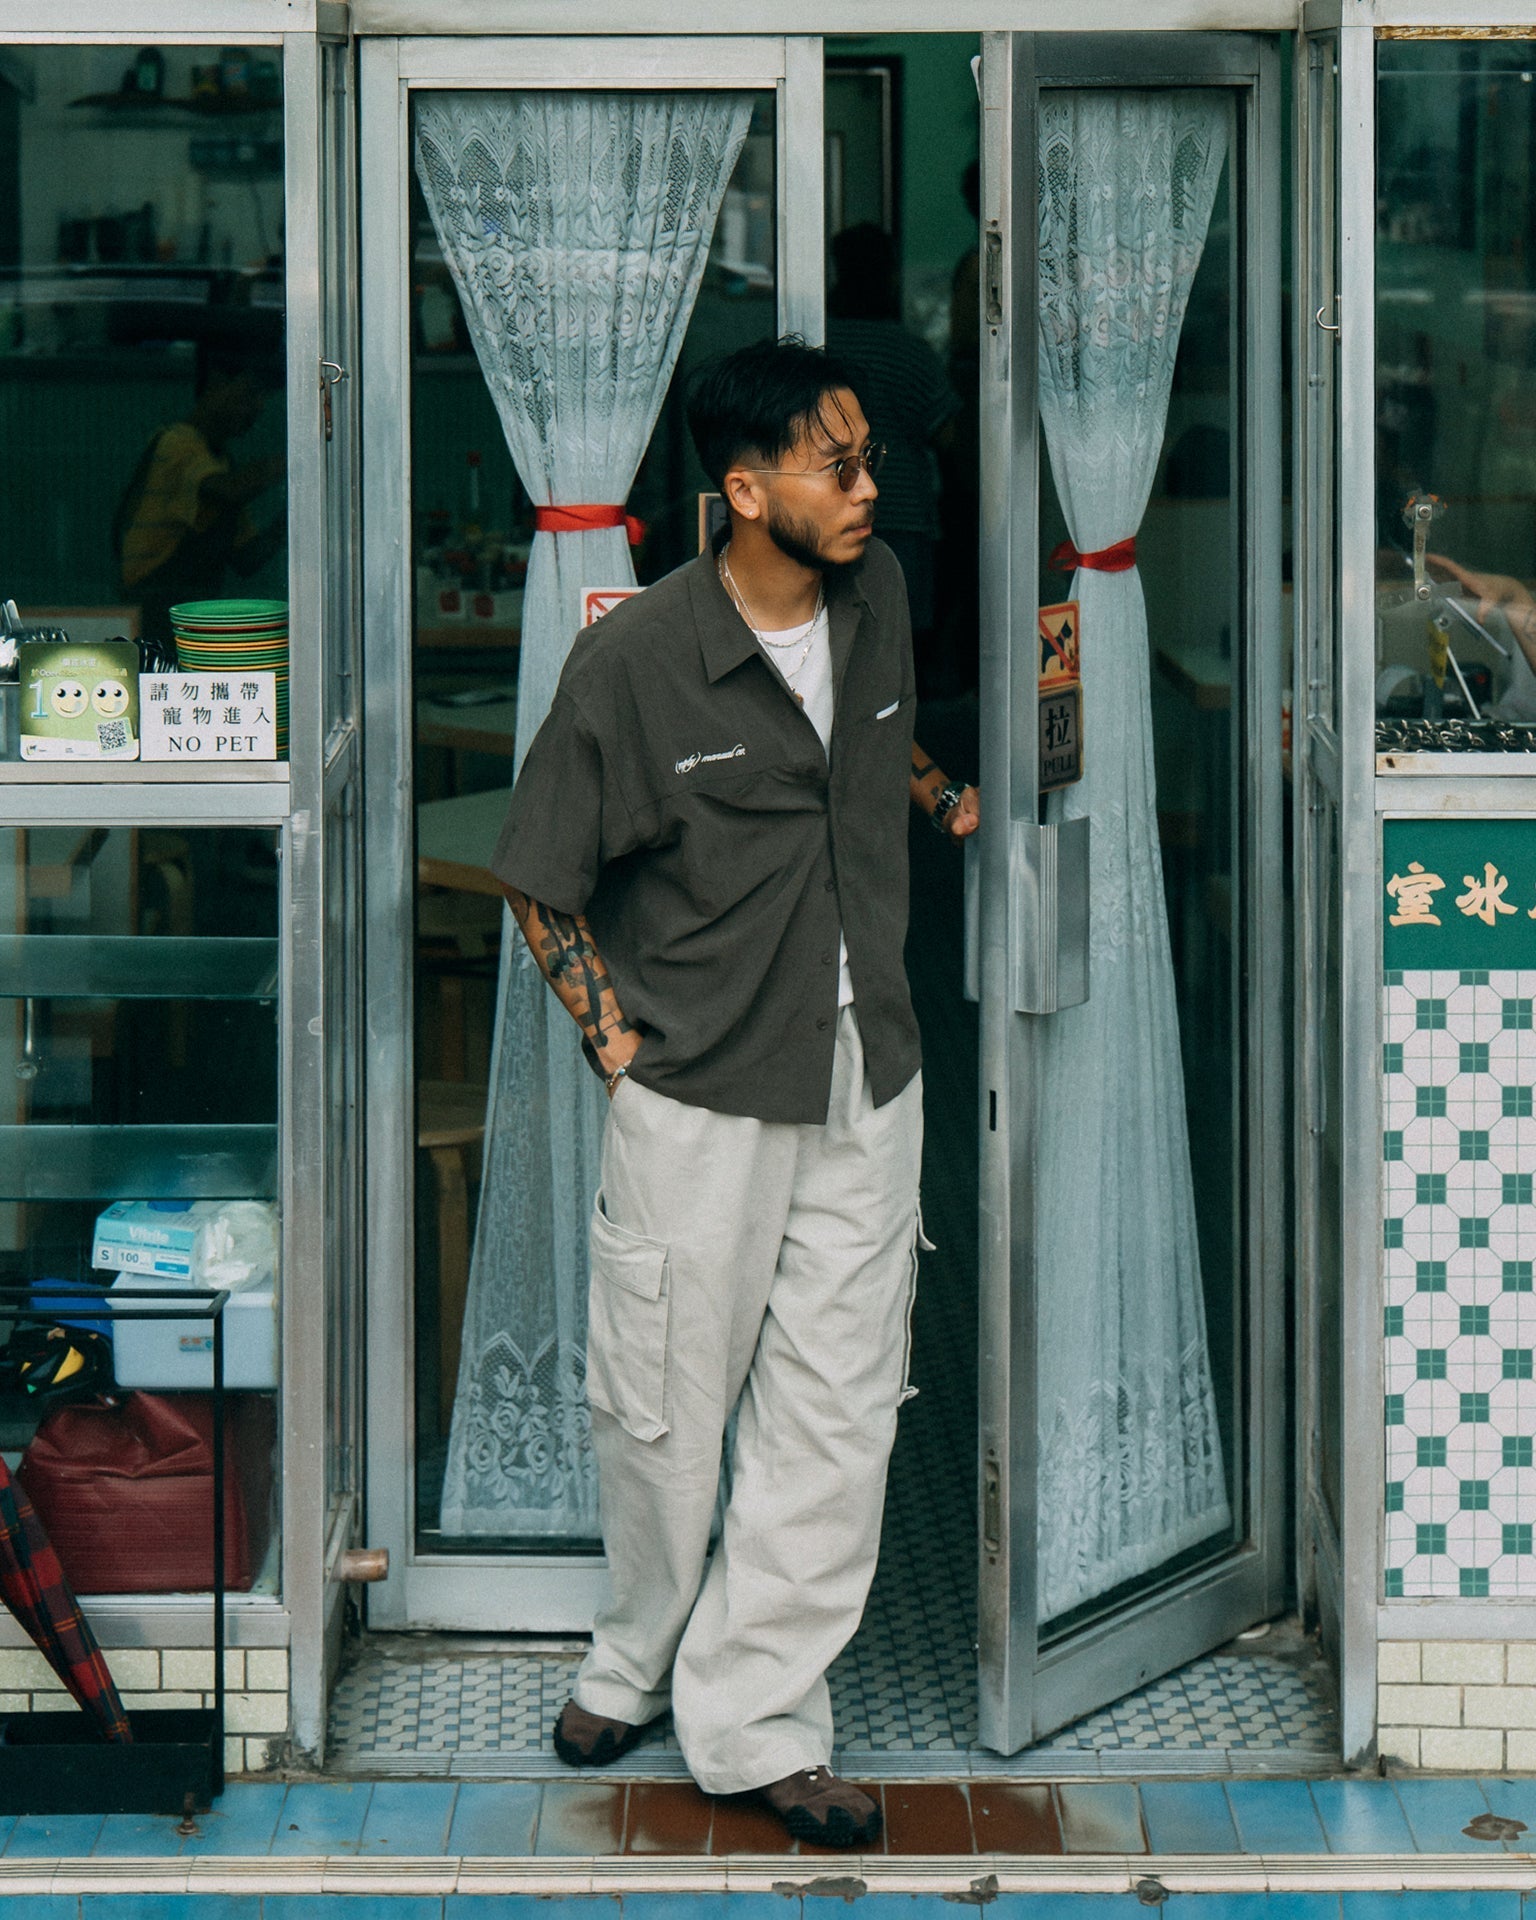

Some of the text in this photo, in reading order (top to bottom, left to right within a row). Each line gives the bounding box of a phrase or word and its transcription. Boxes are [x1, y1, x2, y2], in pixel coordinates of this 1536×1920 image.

[150, 682, 259, 701] 請勿攜帶
[162, 707, 271, 725] 寵物進入
[1045, 705, 1072, 752] 拉
[168, 736, 258, 752] NO PET
[1043, 754, 1075, 777] PULL
[1386, 861, 1536, 927] 室冰
[101, 1249, 109, 1261] S
[120, 1252, 139, 1263] 100
